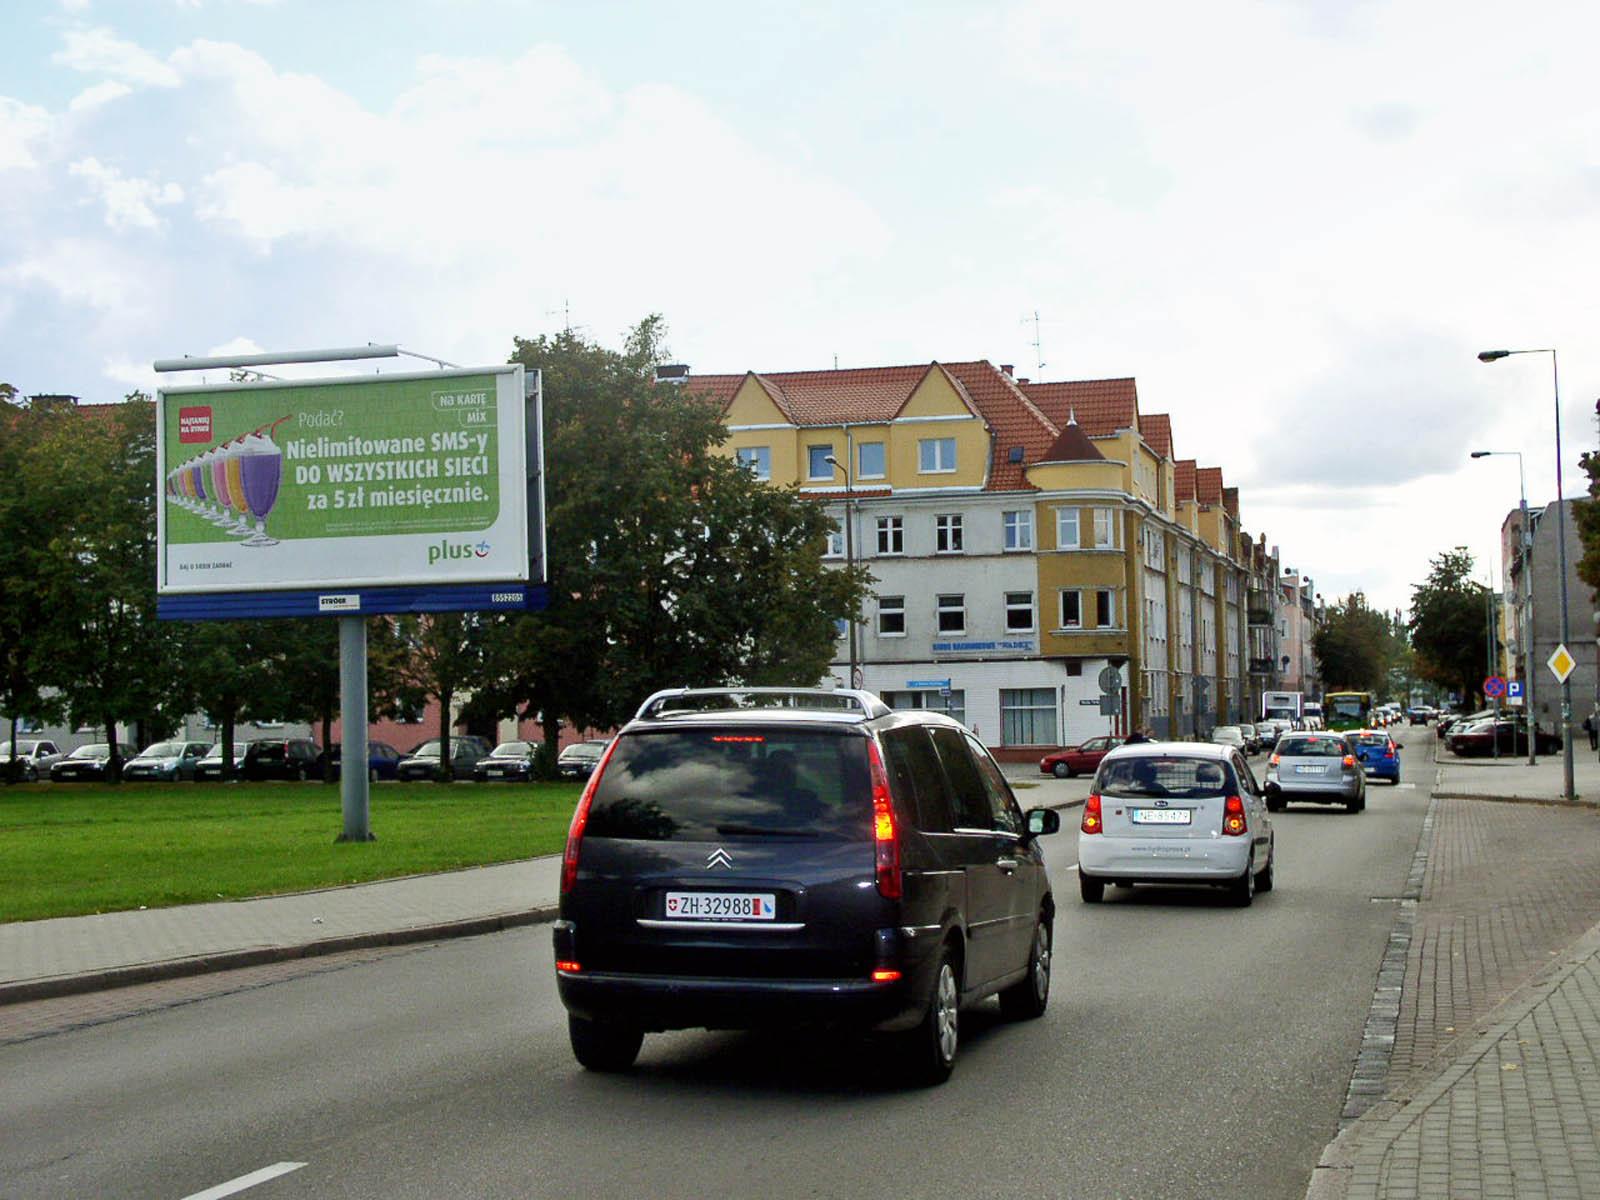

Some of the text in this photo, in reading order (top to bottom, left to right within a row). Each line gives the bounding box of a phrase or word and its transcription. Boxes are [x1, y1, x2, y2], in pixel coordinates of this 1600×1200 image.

[299, 409, 344, 428] Podać?
[286, 431, 488, 460] Nielimitowane SMS-y
[295, 456, 488, 485] DO WSZYSTKICH SIECI
[307, 493, 328, 510] za
[370, 481, 489, 509] miesięcznie.
[428, 540, 472, 565] plus
[1509, 682, 1519, 696] P
